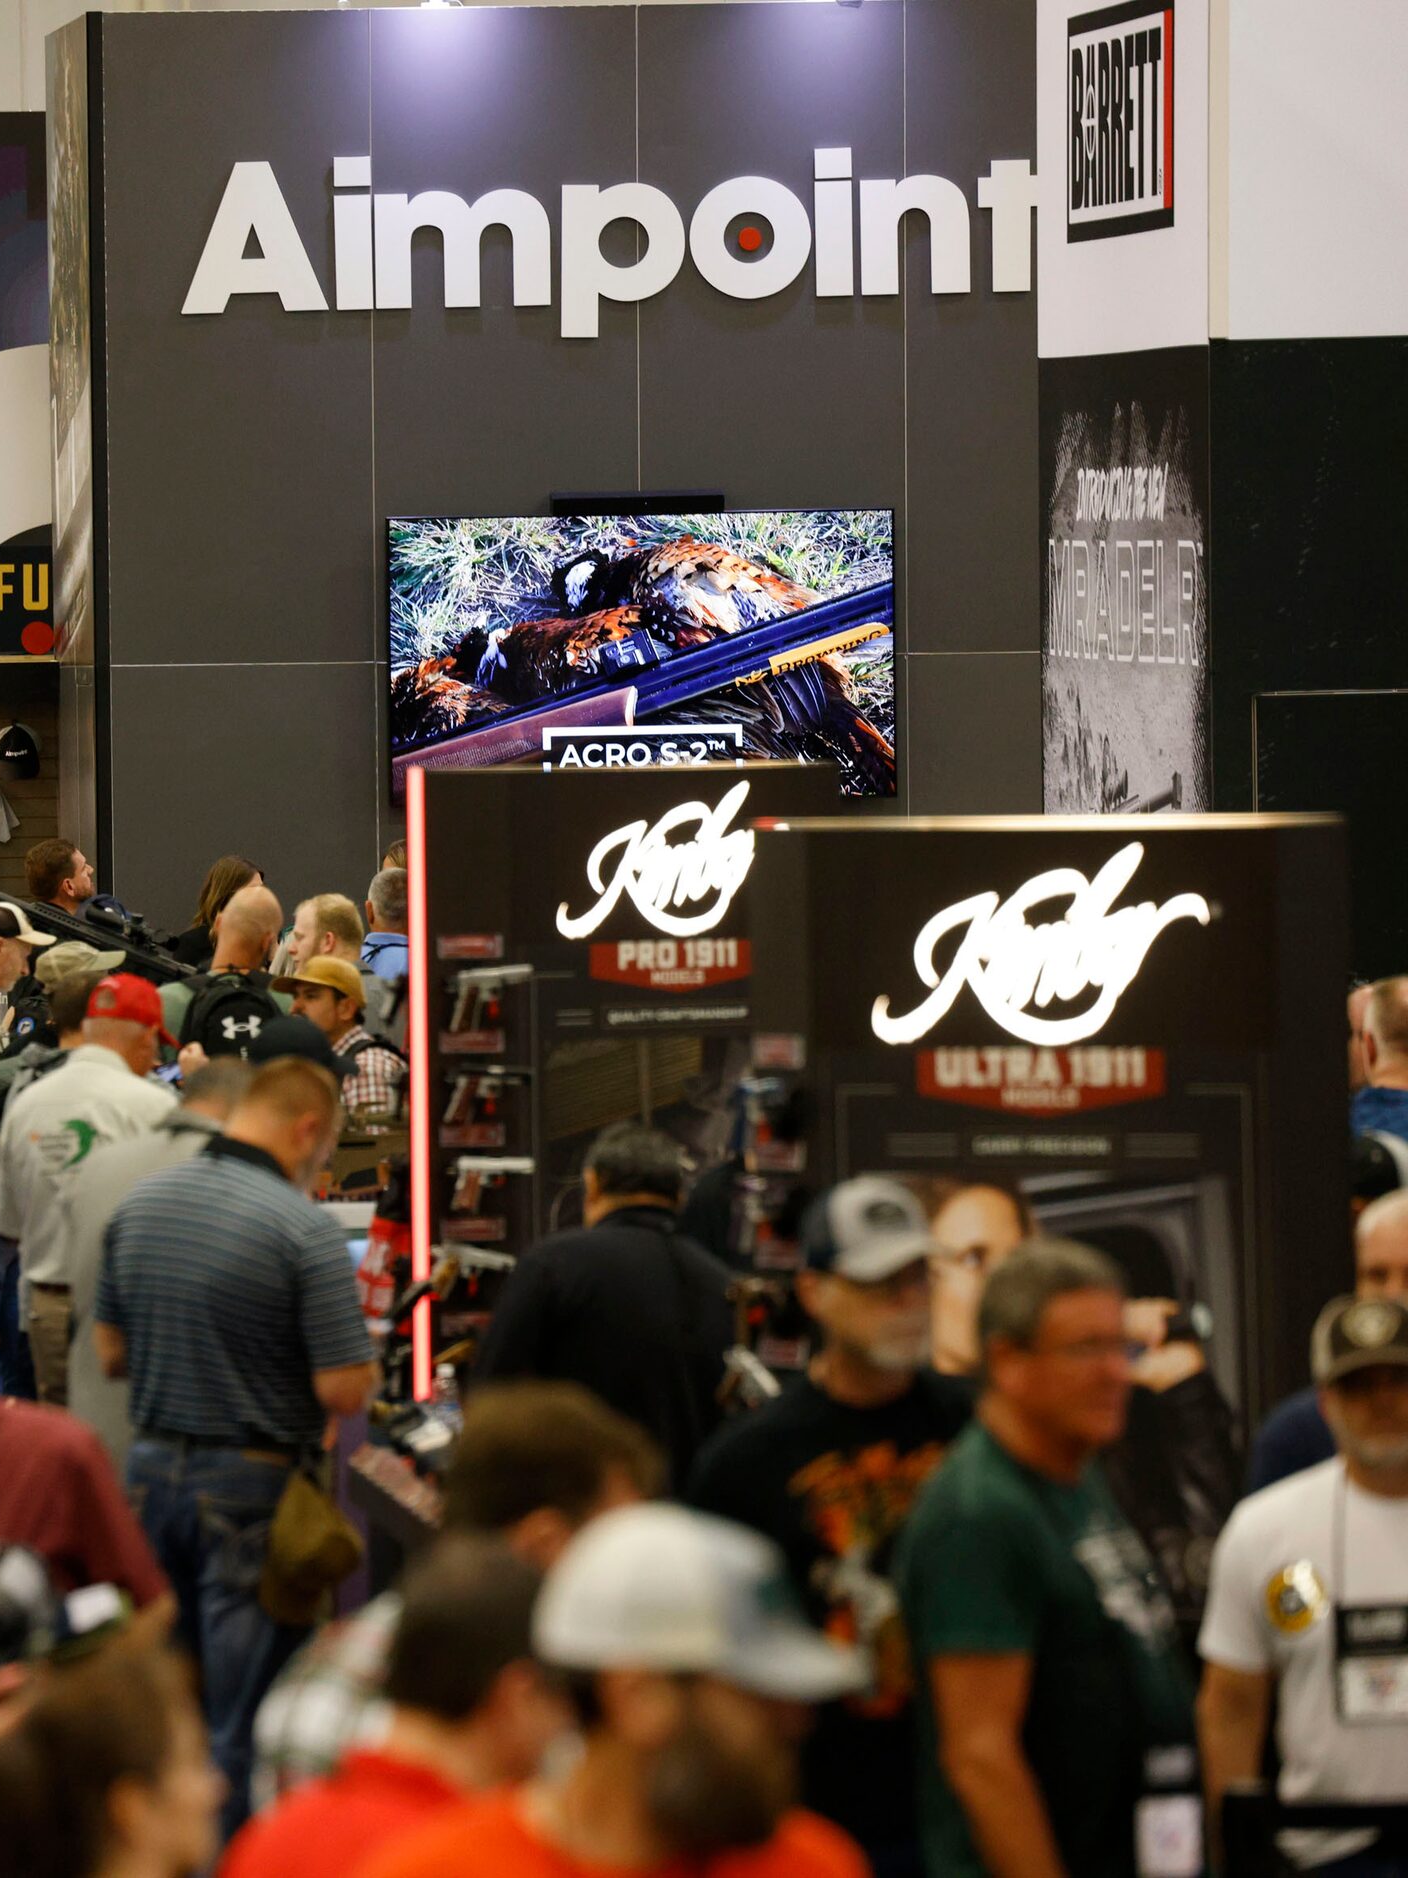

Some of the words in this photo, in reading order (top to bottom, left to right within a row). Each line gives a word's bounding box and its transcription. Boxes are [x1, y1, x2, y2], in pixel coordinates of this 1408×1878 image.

[1071, 26, 1162, 210] BARRETT
[180, 147, 1038, 338] Aimpoint
[558, 743, 652, 768] ACRO
[617, 939, 677, 971] PRO
[683, 937, 738, 968] 1911
[933, 1045, 1064, 1089] ULTRA
[1068, 1045, 1147, 1088] 1911
